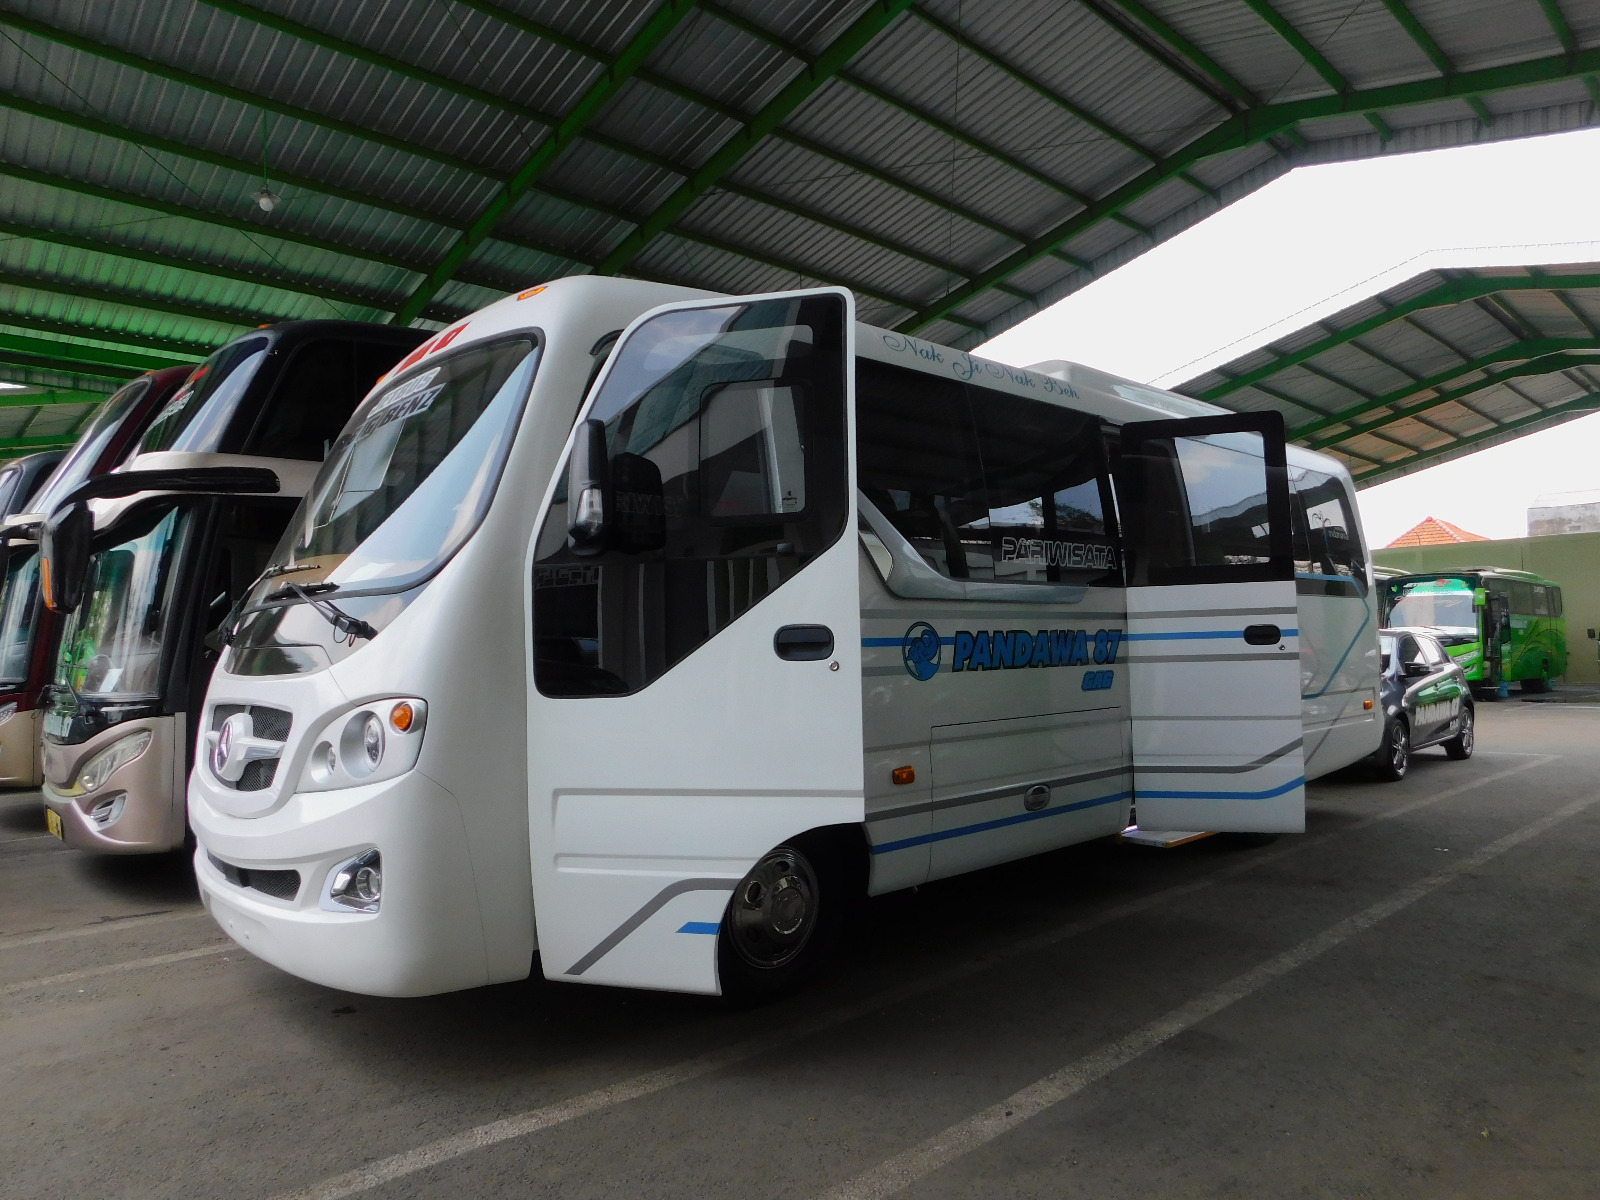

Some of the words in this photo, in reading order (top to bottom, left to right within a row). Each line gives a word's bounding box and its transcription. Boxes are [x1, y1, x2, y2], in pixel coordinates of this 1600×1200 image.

[883, 335, 944, 363] Nak
[985, 363, 1036, 388] Nak
[377, 386, 442, 428] BENZ
[1002, 537, 1117, 570] PARIWISATA
[952, 629, 1089, 672] PANDAWA
[1093, 629, 1122, 664] 87
